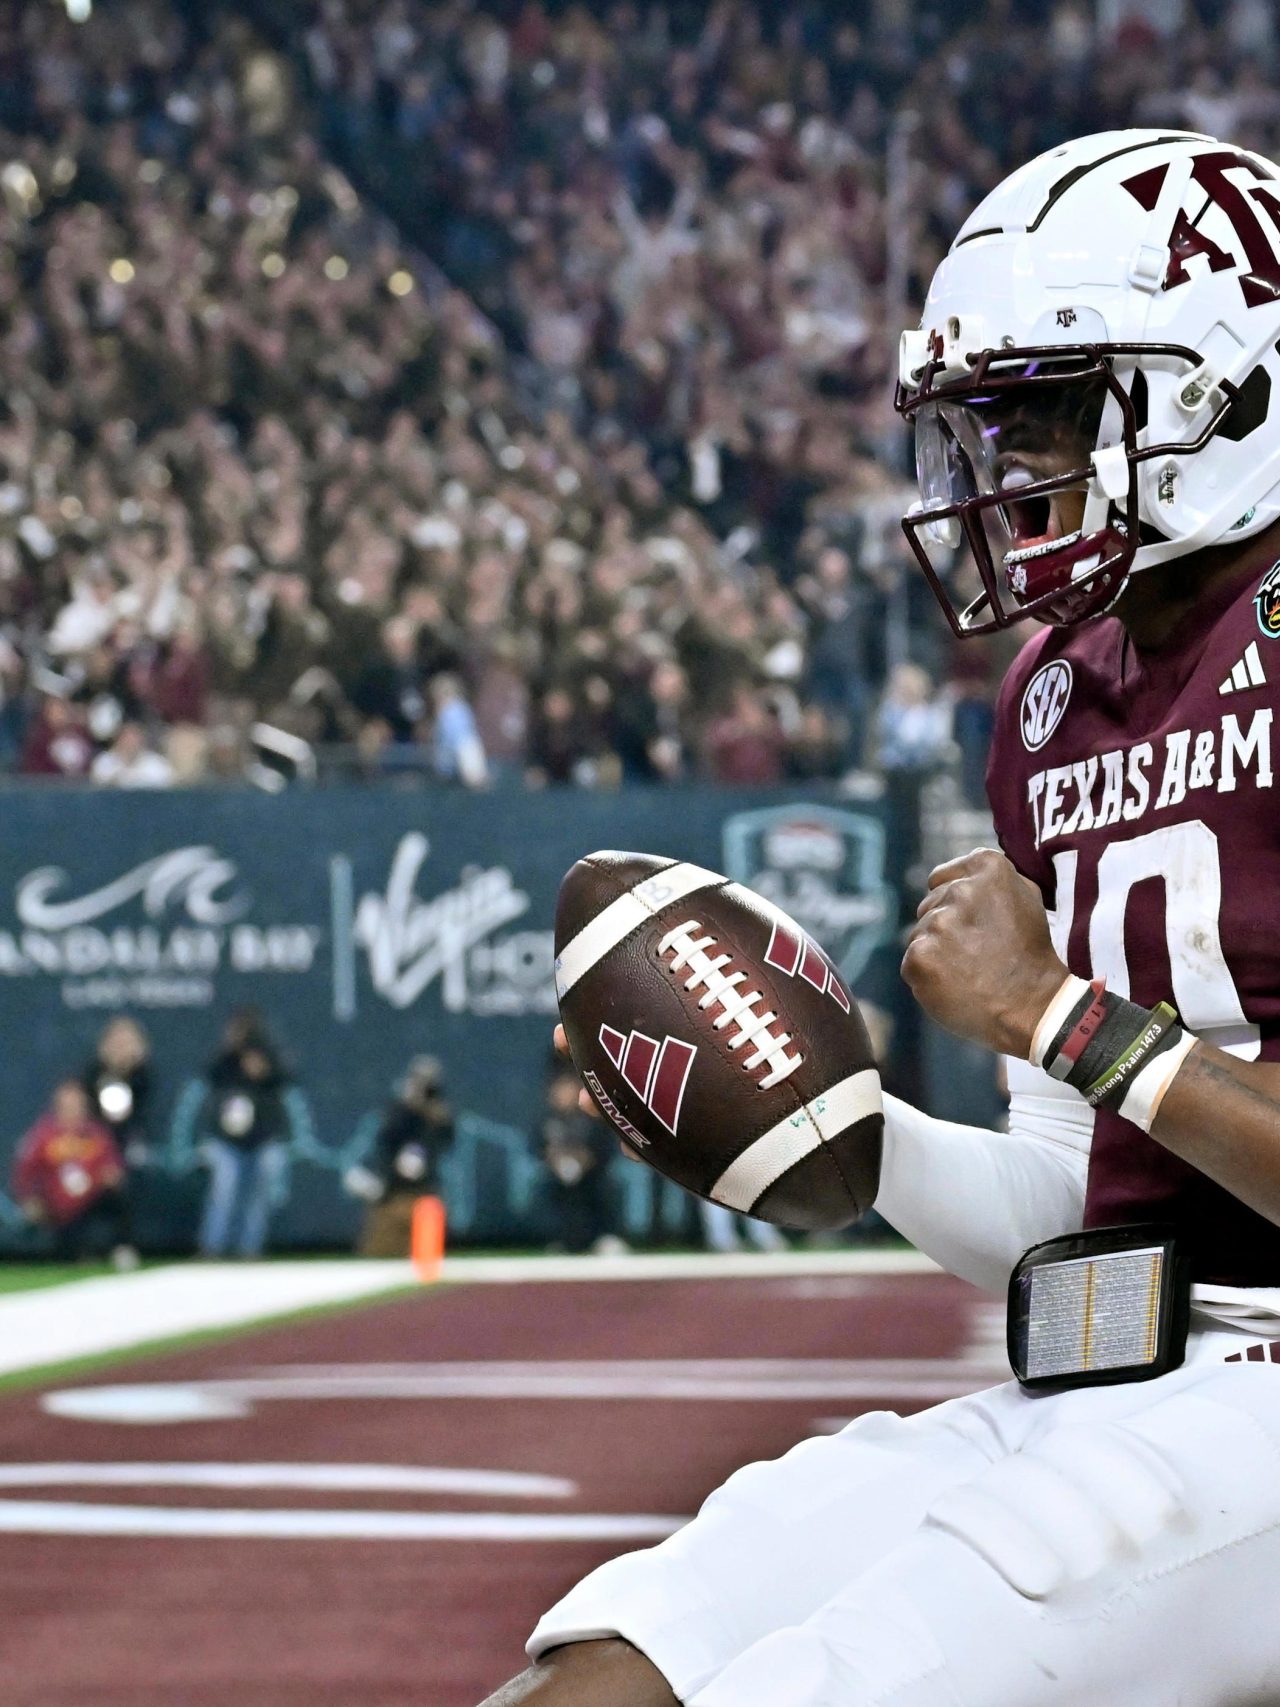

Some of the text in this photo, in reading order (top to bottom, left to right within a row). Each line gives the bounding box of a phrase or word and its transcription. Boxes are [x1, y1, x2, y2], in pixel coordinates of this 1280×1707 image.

[1023, 666, 1069, 745] SEC
[1028, 708, 1273, 850] TEXAS A&M
[1093, 1023, 1162, 1098] Strong Psalm 147:3
[583, 1070, 652, 1149] DIME
